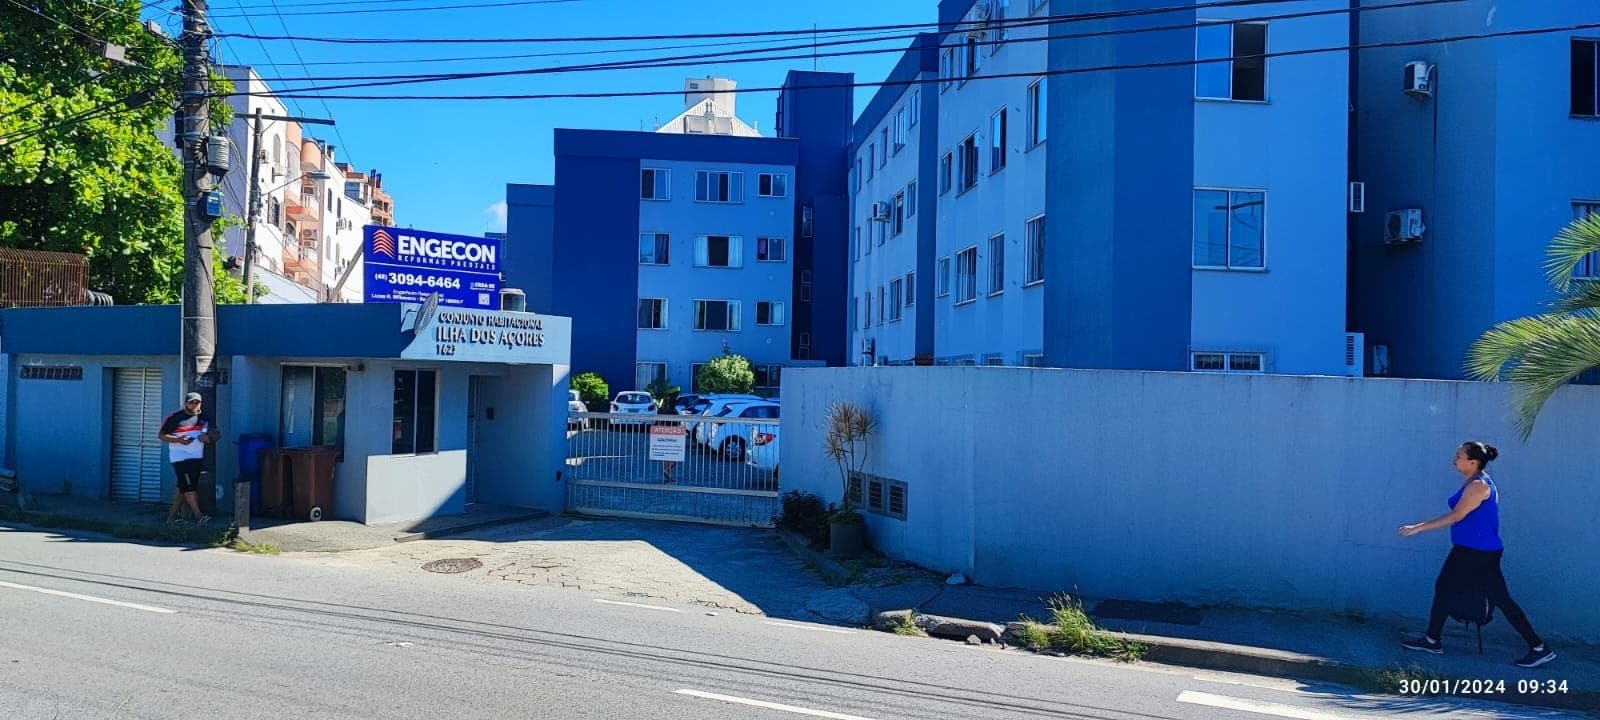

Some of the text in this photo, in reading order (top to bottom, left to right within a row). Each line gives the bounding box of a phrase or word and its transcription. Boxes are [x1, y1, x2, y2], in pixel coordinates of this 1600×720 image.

[398, 235, 496, 263] ENGECON
[398, 255, 446, 266] REFORMAS
[389, 273, 460, 289] 3094-6464
[439, 312, 543, 330] CONJUNTO HABITACIONAL
[436, 326, 544, 350] ILHA DOS AÇORES
